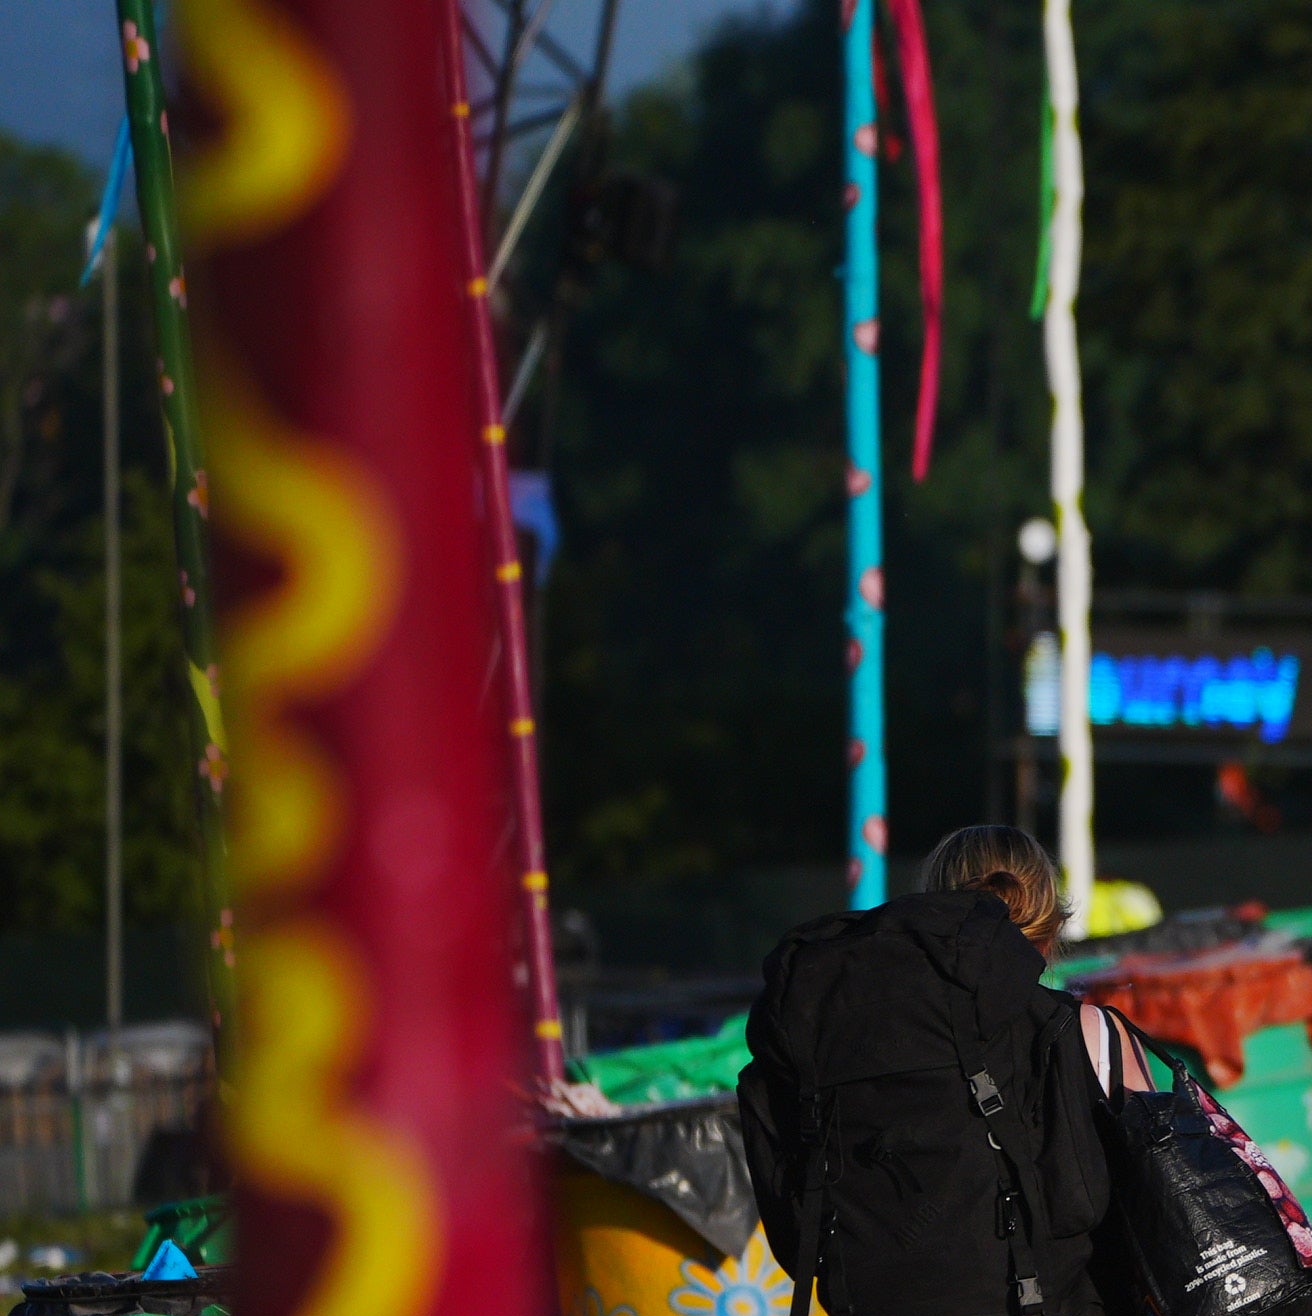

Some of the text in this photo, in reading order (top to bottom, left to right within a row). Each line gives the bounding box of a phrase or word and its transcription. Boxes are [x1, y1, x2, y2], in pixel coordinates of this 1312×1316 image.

[1195, 1245, 1247, 1274] is made from
[1200, 1240, 1235, 1260] This bag
[1203, 1259, 1237, 1281] recycled
[1236, 1248, 1268, 1268] plastics.
[1226, 1292, 1261, 1312] aldi.com
